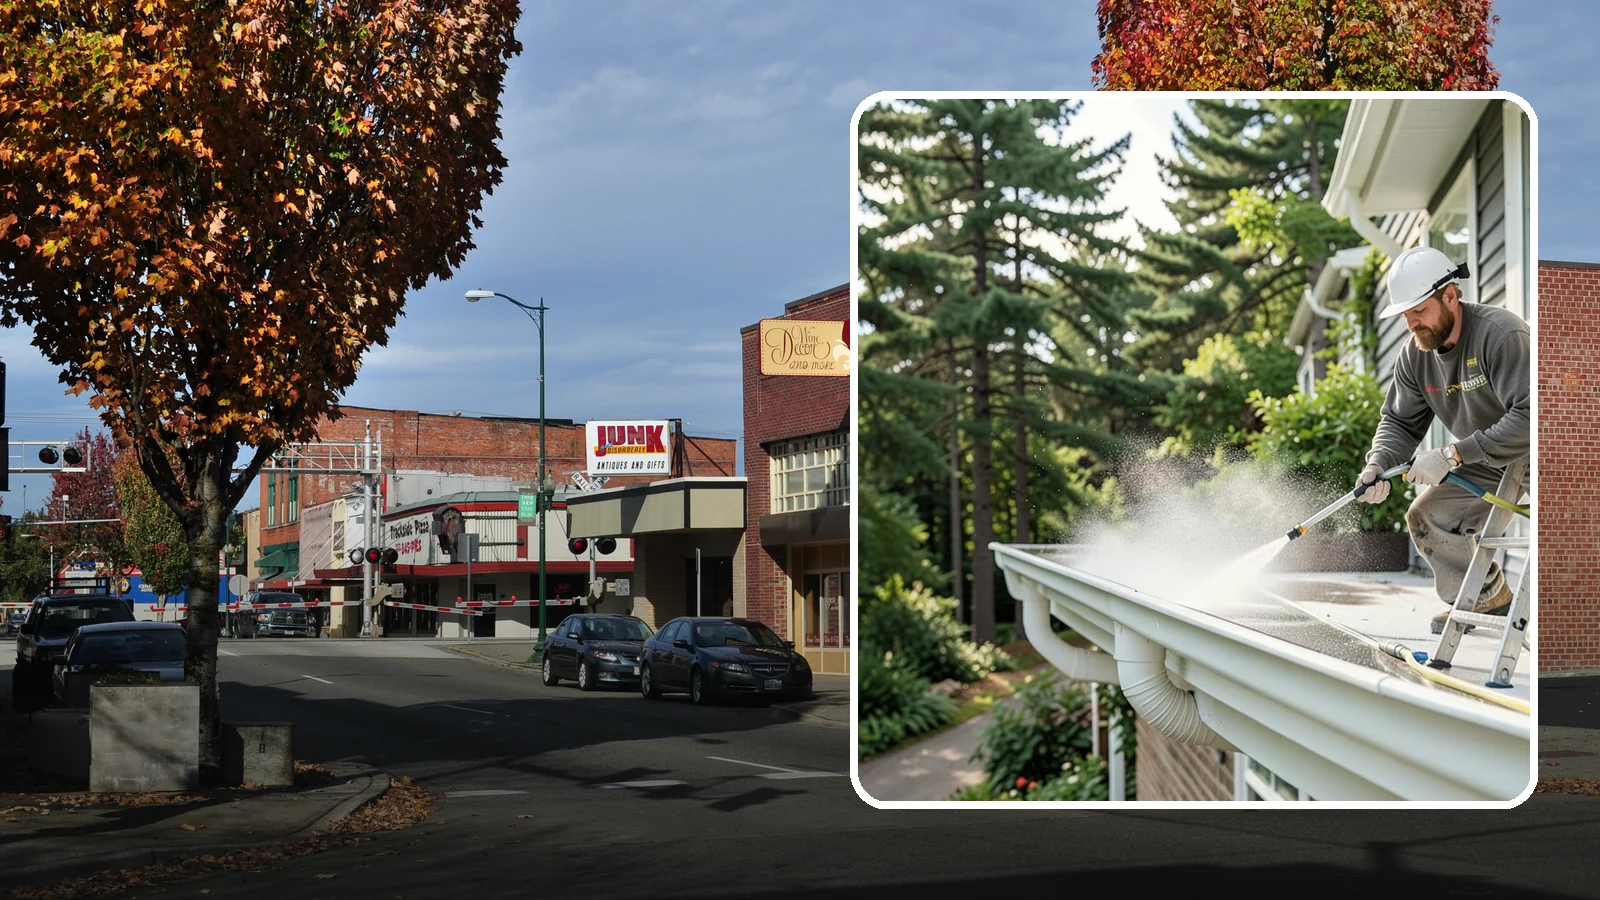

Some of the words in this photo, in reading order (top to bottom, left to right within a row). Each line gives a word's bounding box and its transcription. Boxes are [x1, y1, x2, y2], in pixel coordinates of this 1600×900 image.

[595, 425, 665, 457] JUNK
[607, 446, 645, 454] DISORDERLY
[597, 461, 628, 470] ANTIQUES
[631, 461, 644, 470] AND
[647, 461, 665, 470] GIFTS
[390, 521, 413, 539] Trackside
[415, 519, 429, 535] Pizza
